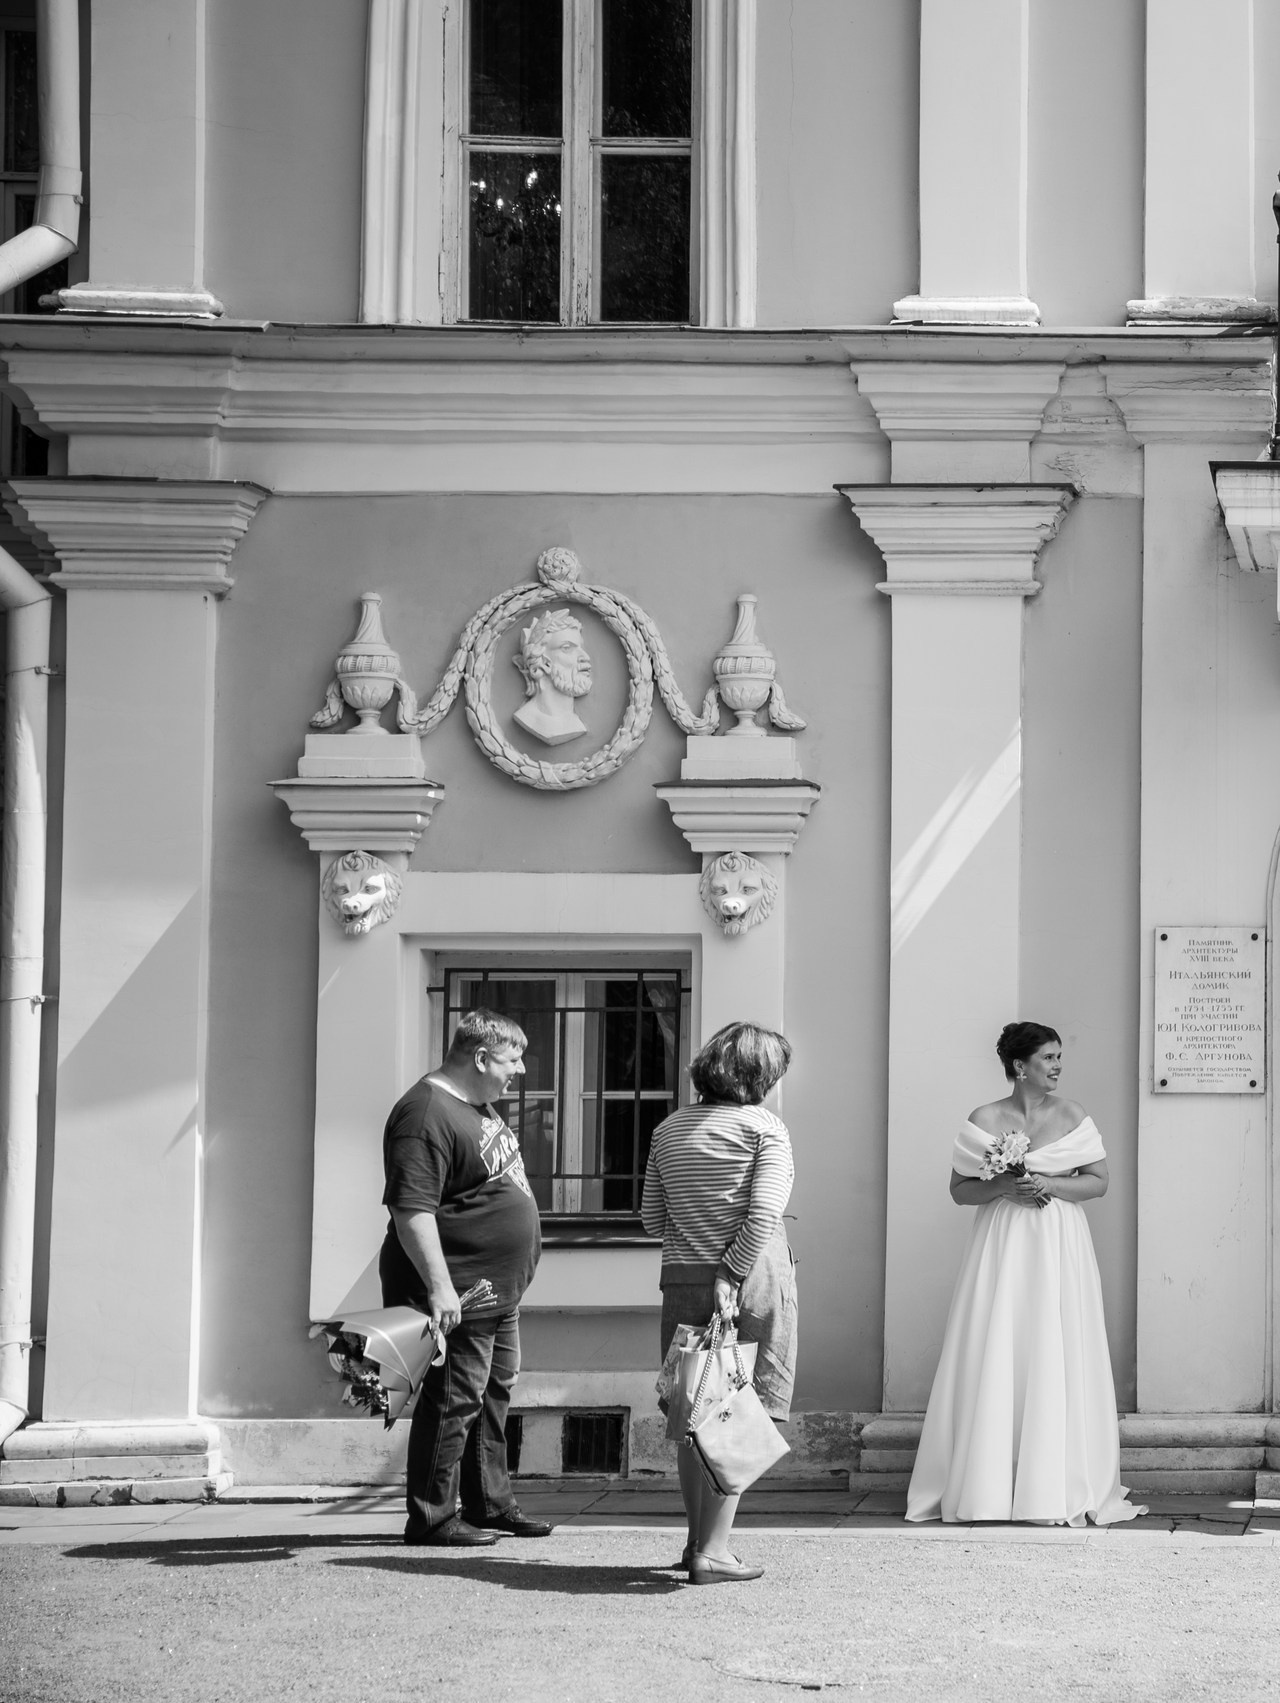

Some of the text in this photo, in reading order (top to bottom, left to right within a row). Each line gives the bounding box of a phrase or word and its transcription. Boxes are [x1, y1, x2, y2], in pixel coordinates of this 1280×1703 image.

[1169, 968, 1252, 979] ИТАЛЬЯНСКИЙ
[1192, 982, 1230, 990] ДОМИК
[1181, 1023, 1262, 1032] КОЛОГРИВОВА
[1195, 1052, 1253, 1061] АРГУНОВА
